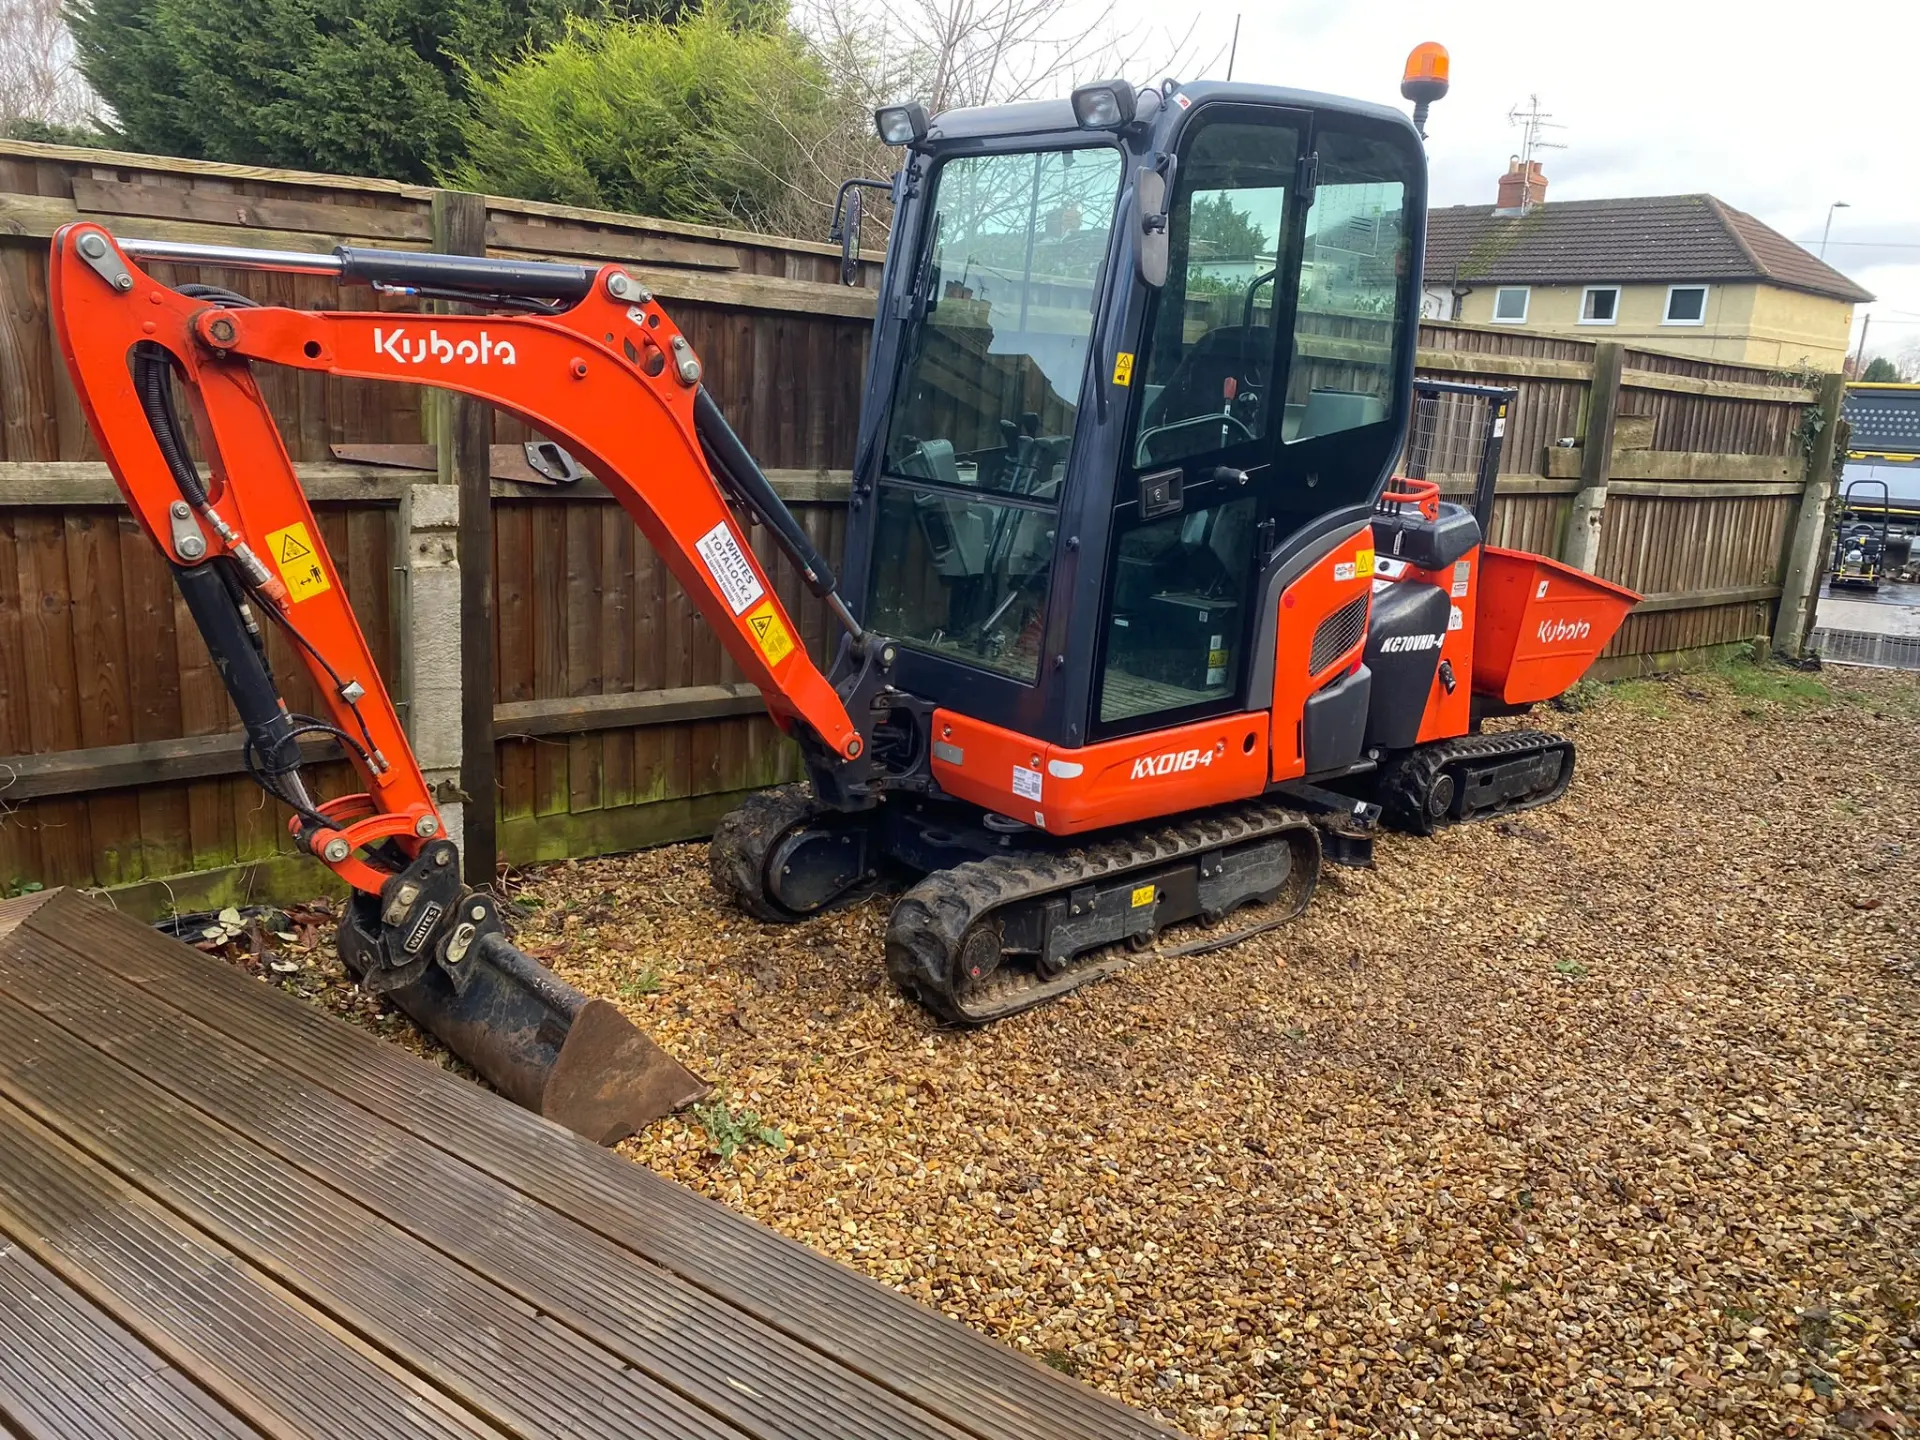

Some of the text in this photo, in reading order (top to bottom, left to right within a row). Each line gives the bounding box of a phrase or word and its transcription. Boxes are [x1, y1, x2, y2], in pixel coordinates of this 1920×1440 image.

[373, 327, 516, 365] Kubota
[708, 533, 752, 602] TOTALOCK 2
[724, 537, 754, 584] WHITES
[1380, 633, 1444, 652] KC70VHD-4
[1537, 618, 1591, 643] Kubota
[1130, 749, 1213, 780] KX018-4
[408, 909, 437, 947] WHITES
